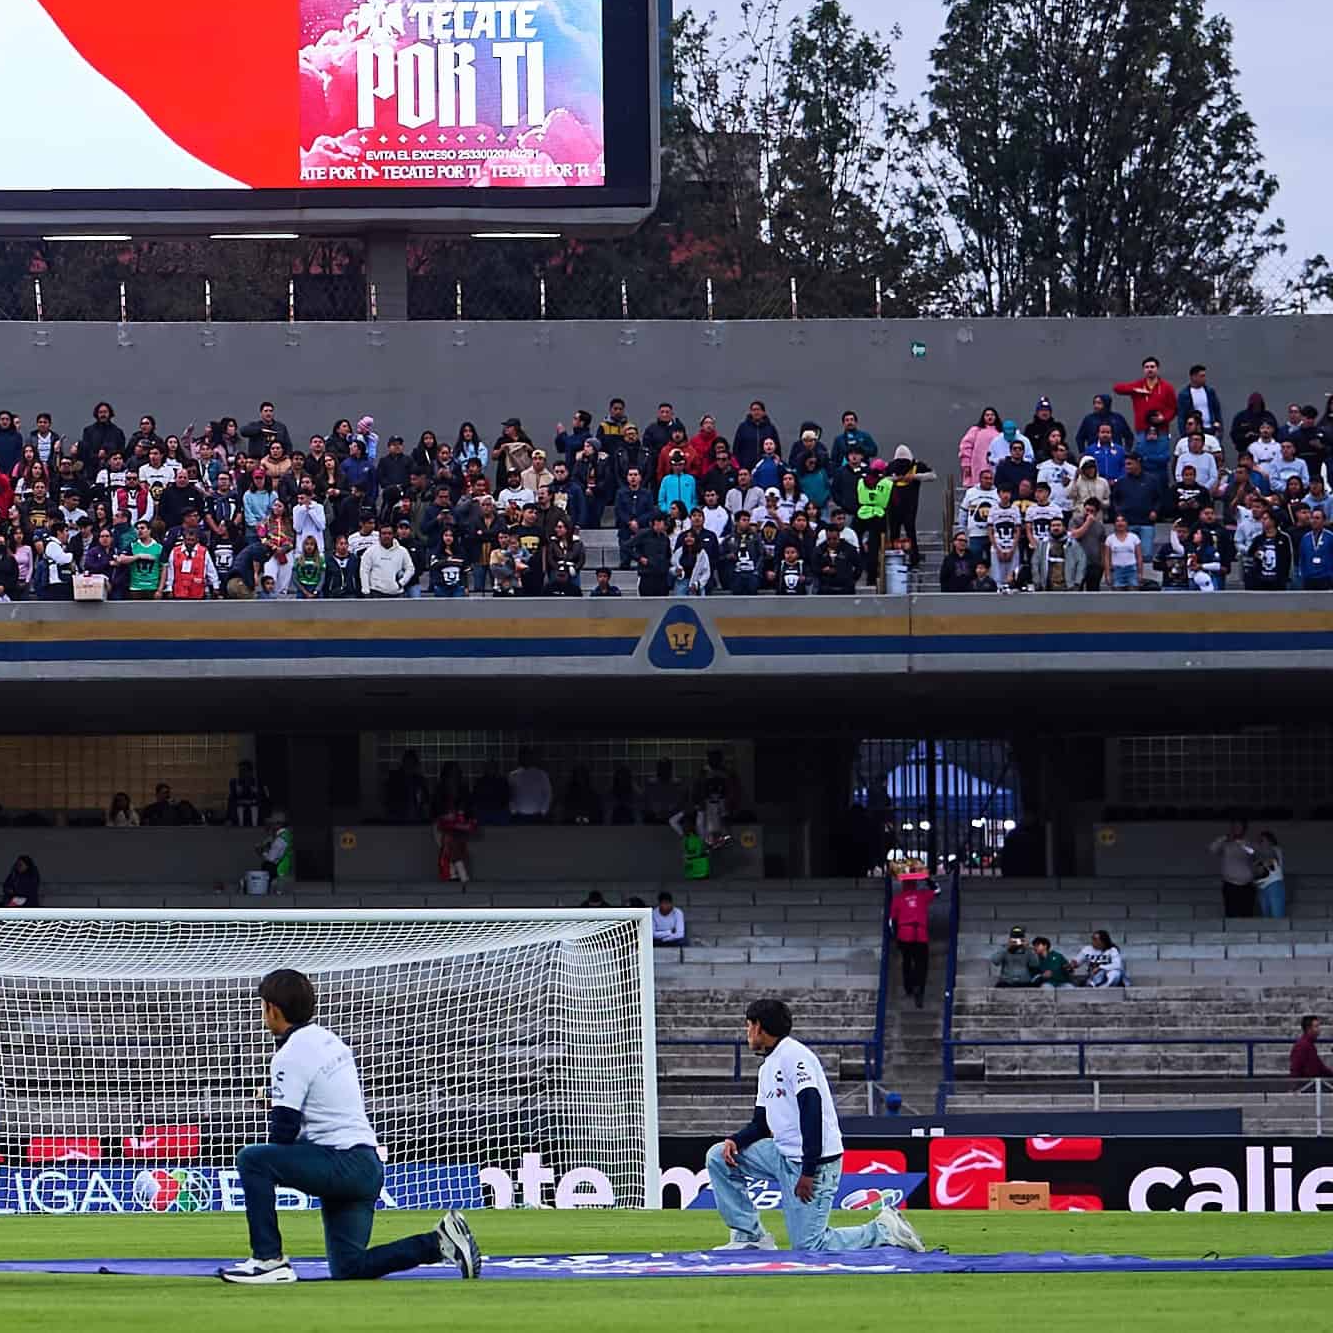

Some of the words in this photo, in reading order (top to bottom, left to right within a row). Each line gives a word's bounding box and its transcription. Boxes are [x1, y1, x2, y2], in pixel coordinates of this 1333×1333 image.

[410, 1, 541, 39] TECATE
[356, 41, 477, 129] POR
[492, 41, 545, 128] TI
[365, 150, 397, 161] EVITA
[412, 149, 456, 161] EXCESO
[329, 166, 356, 179] POR
[381, 165, 435, 179] TECATE
[437, 165, 464, 179] POR
[491, 165, 542, 178] TECATE
[546, 164, 574, 178] POR
